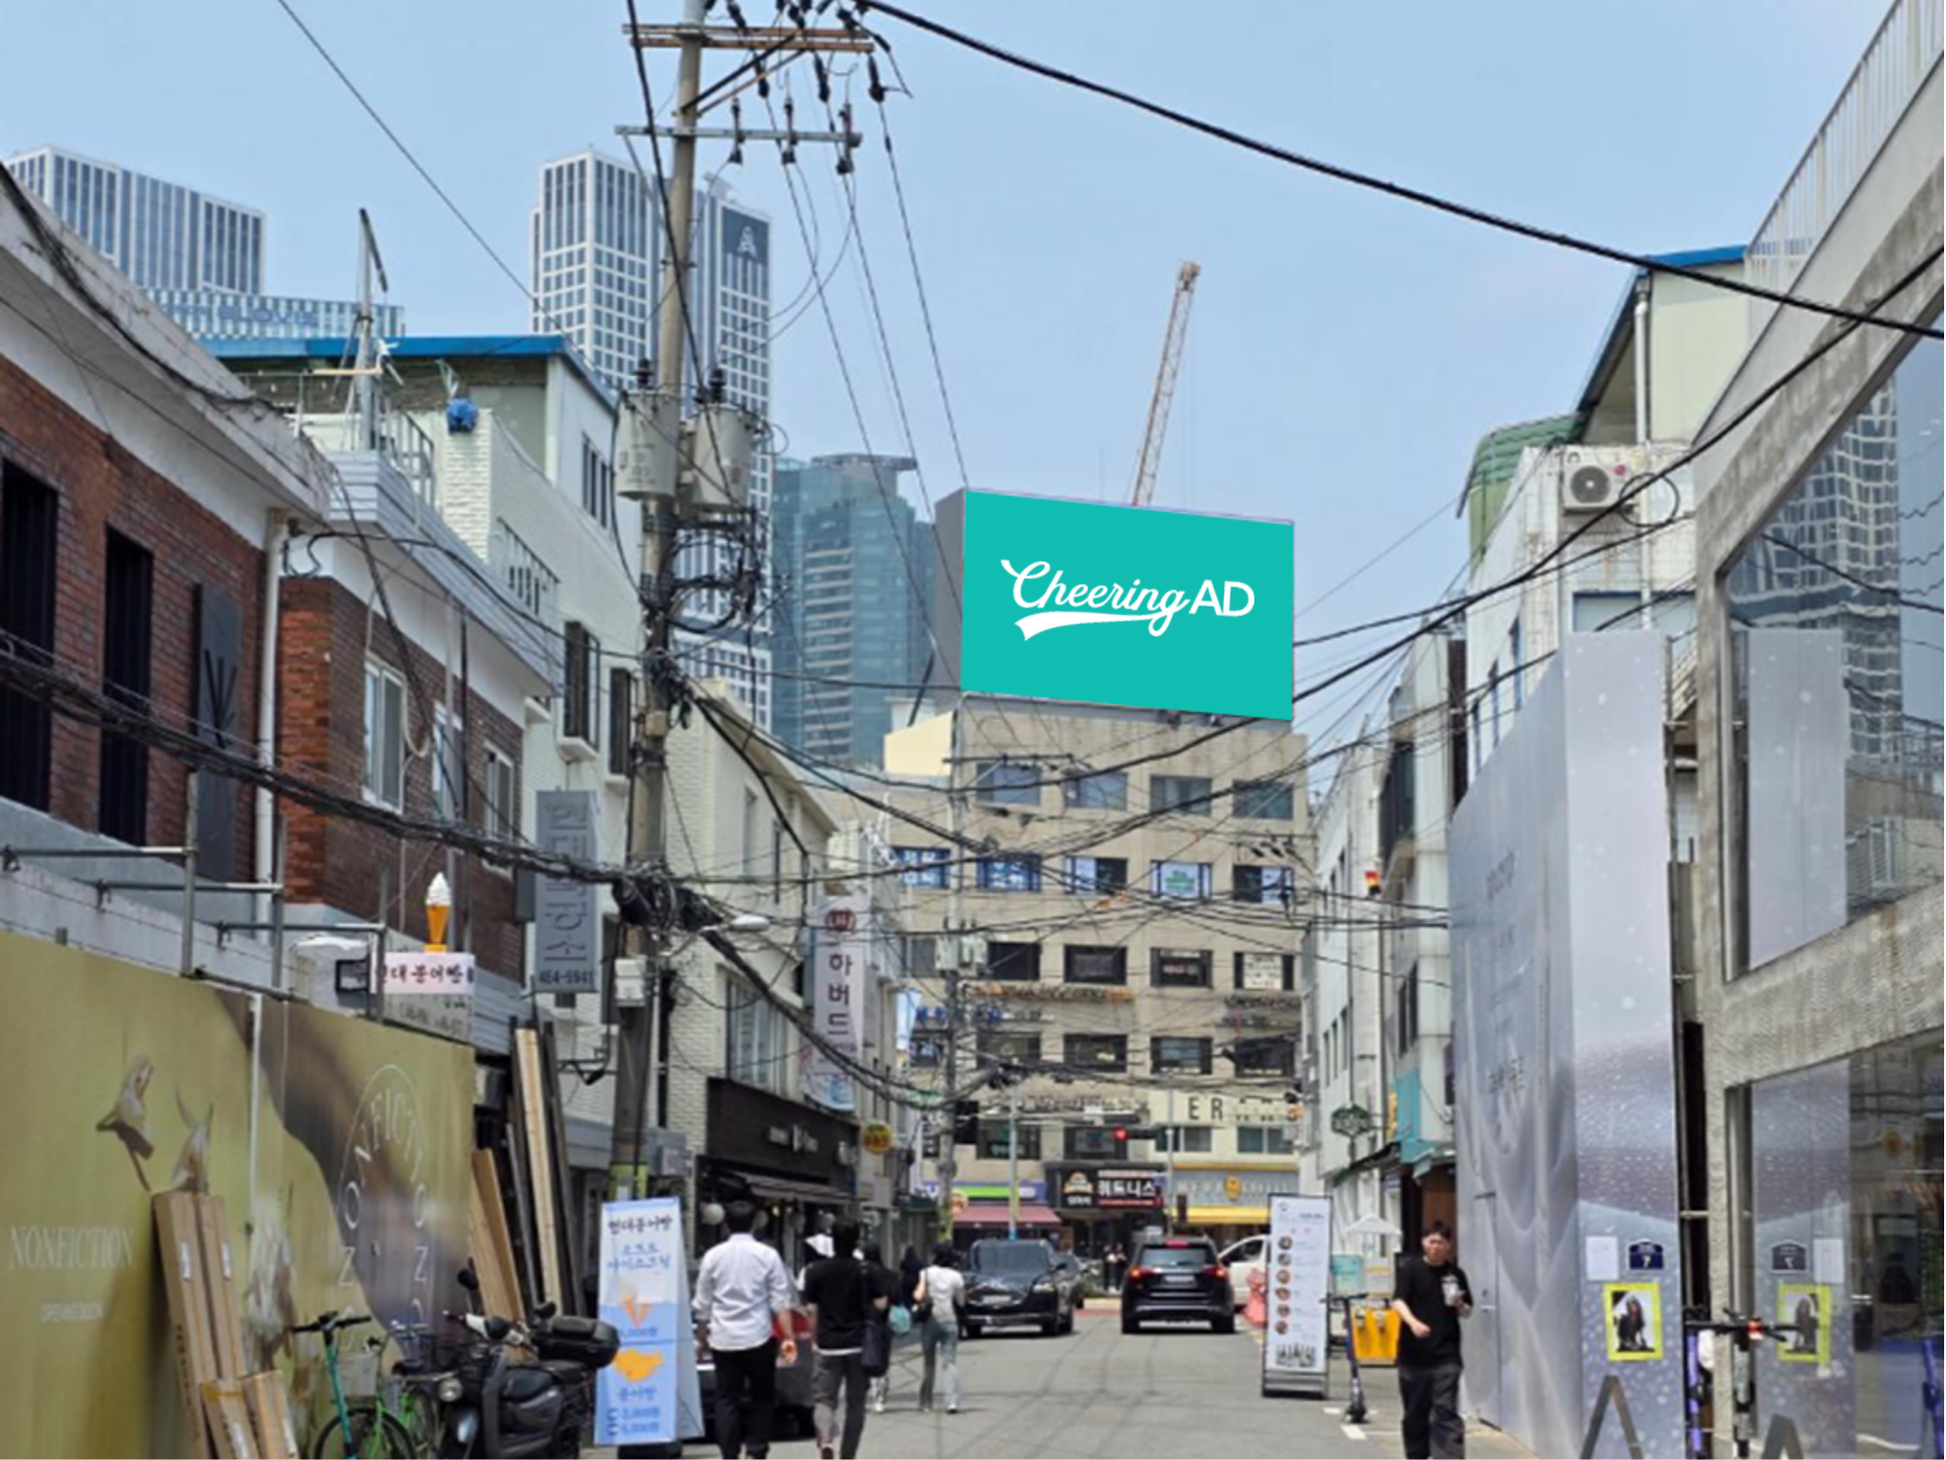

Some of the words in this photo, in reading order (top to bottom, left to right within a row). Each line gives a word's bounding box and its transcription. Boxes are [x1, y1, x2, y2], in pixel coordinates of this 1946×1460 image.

[1001, 559, 1190, 638] Cheering
[1189, 579, 1255, 617] AD
[411, 964, 463, 984] 붕어빵
[827, 953, 852, 1035] 하버드
[9, 1226, 134, 1269] NONFICTION
